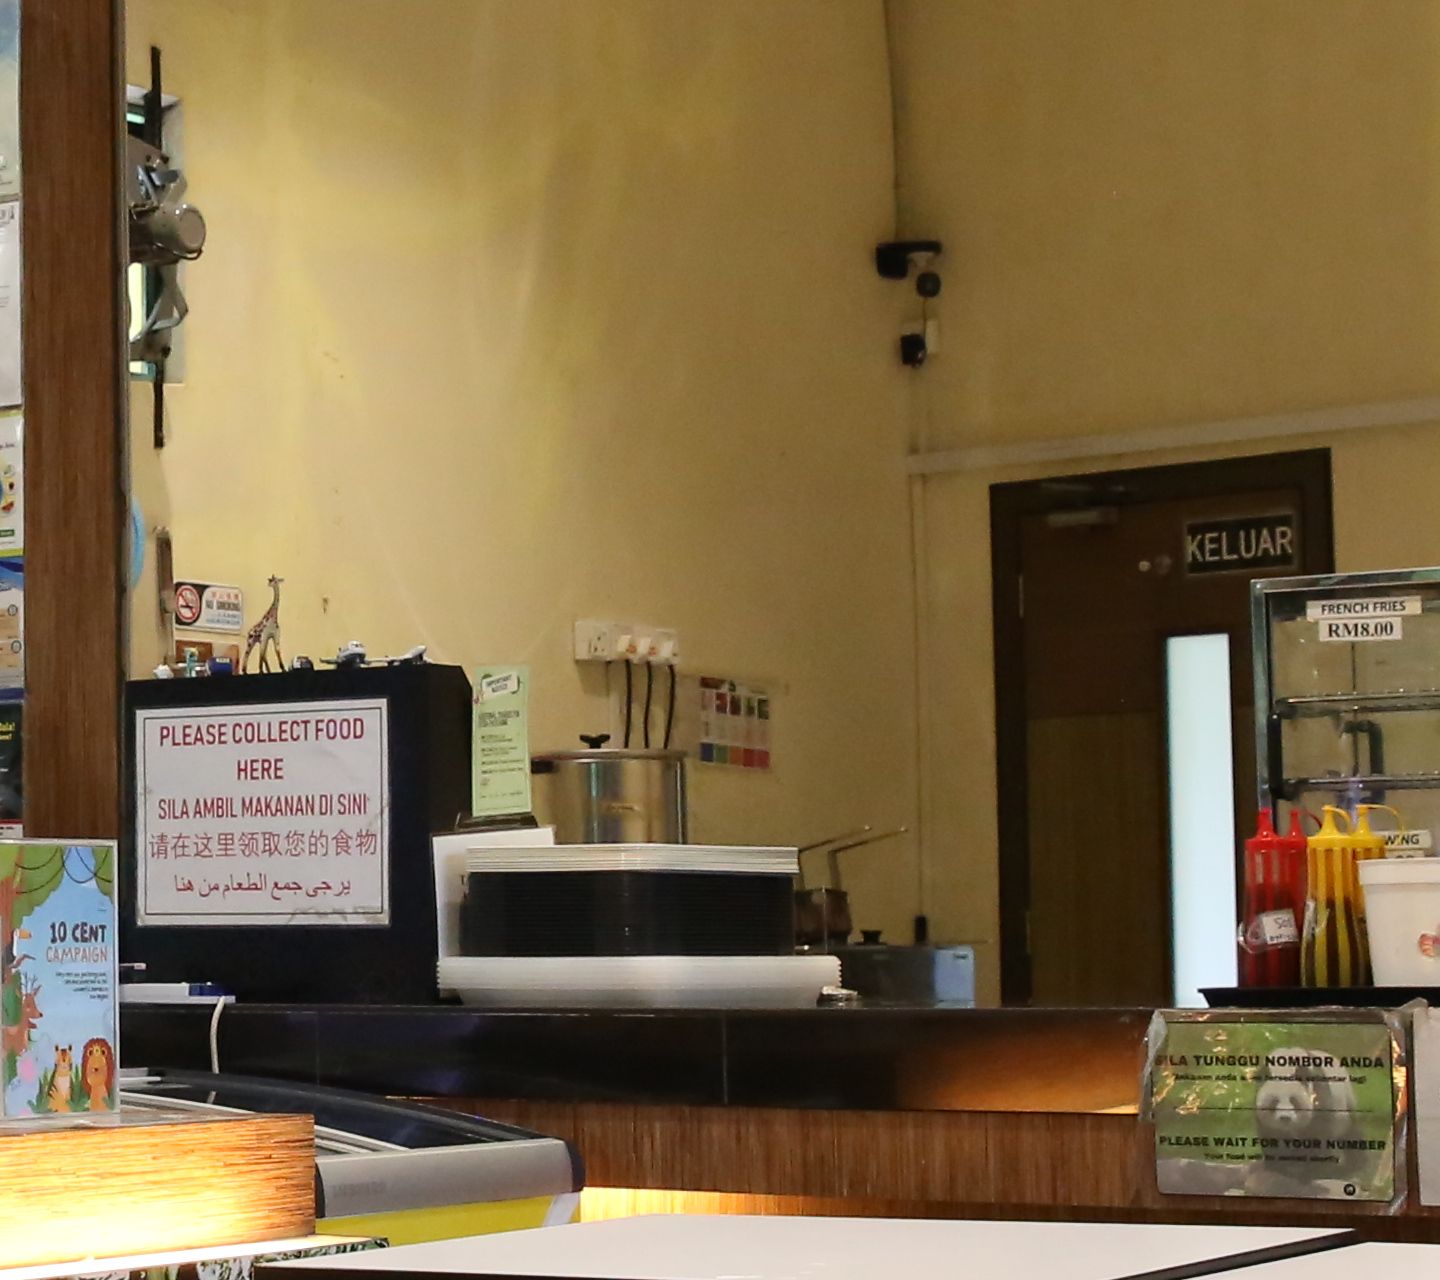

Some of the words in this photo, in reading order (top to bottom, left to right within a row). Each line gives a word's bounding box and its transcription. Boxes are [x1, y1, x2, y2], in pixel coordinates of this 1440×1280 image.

[1185, 525, 1293, 562] KELUAR
[1321, 602, 1369, 615] FRENCH
[1373, 601, 1406, 612] FRIES
[1328, 620, 1394, 638] RM8.00
[160, 724, 227, 746] PLEASE
[232, 720, 310, 743] COLLECT
[315, 718, 364, 741] FOOD
[237, 759, 284, 780] HERE
[158, 798, 189, 819] SILA
[193, 797, 237, 818] AMBIL
[241, 795, 314, 817] MAKANAN
[320, 794, 333, 815] DI
[338, 793, 367, 815] SINI
[149, 828, 377, 860] 请在这里领取您的食物
[50, 922, 67, 943] 10
[72, 923, 106, 943] CENT
[46, 946, 108, 964] CAMPAIGN
[1194, 1056, 1259, 1066] TUNGGU
[1265, 1056, 1333, 1067] NOMBOR
[1340, 1057, 1384, 1068] ANDA
[1160, 1136, 1209, 1146] PLEASE
[1215, 1137, 1247, 1147] WAIT
[1252, 1138, 1278, 1148] FOR
[1285, 1139, 1321, 1149] YOUR
[1326, 1139, 1386, 1150] NUMBER
